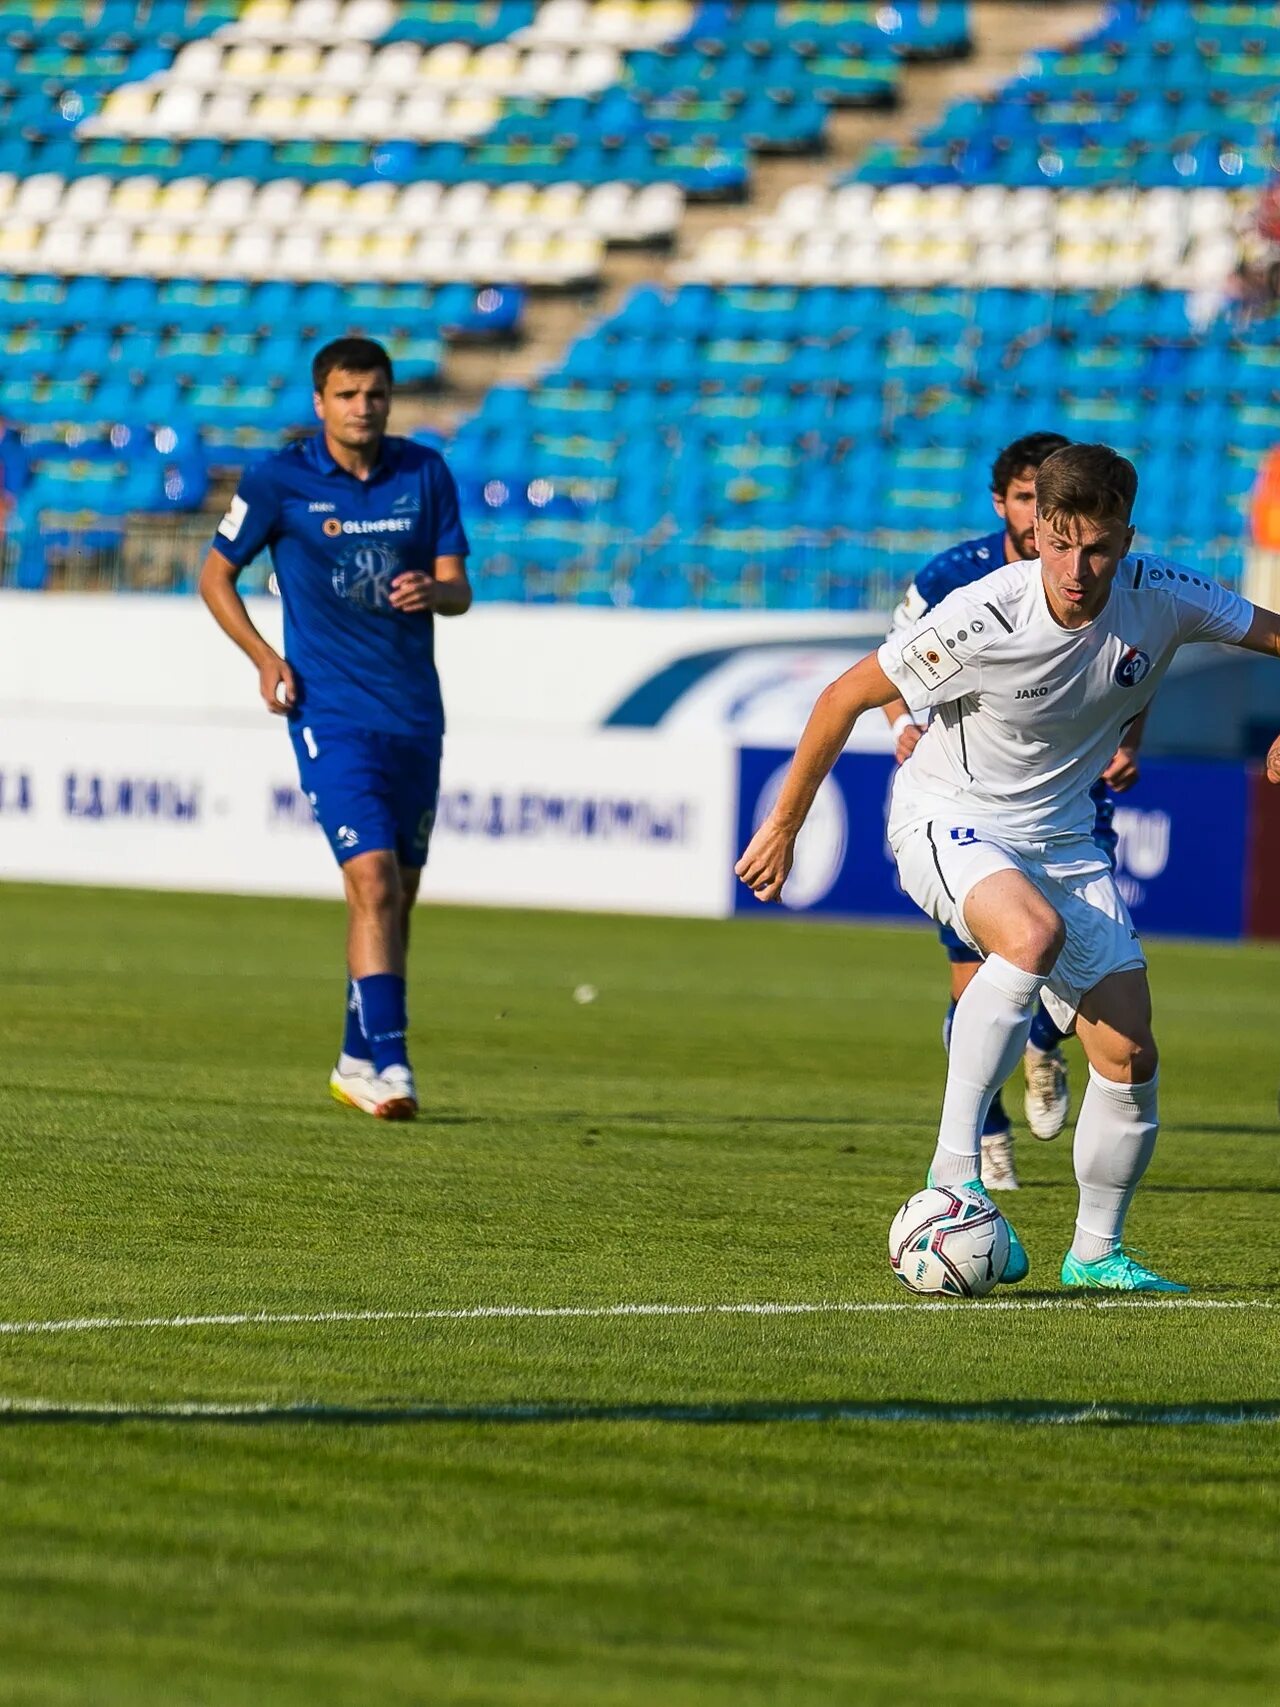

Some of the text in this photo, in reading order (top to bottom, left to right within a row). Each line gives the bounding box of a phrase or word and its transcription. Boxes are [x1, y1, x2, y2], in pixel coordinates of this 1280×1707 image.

[342, 518, 411, 534] OLIMPBET
[910, 645, 942, 680] OLIMPBET
[1014, 686, 1049, 700] JAKO
